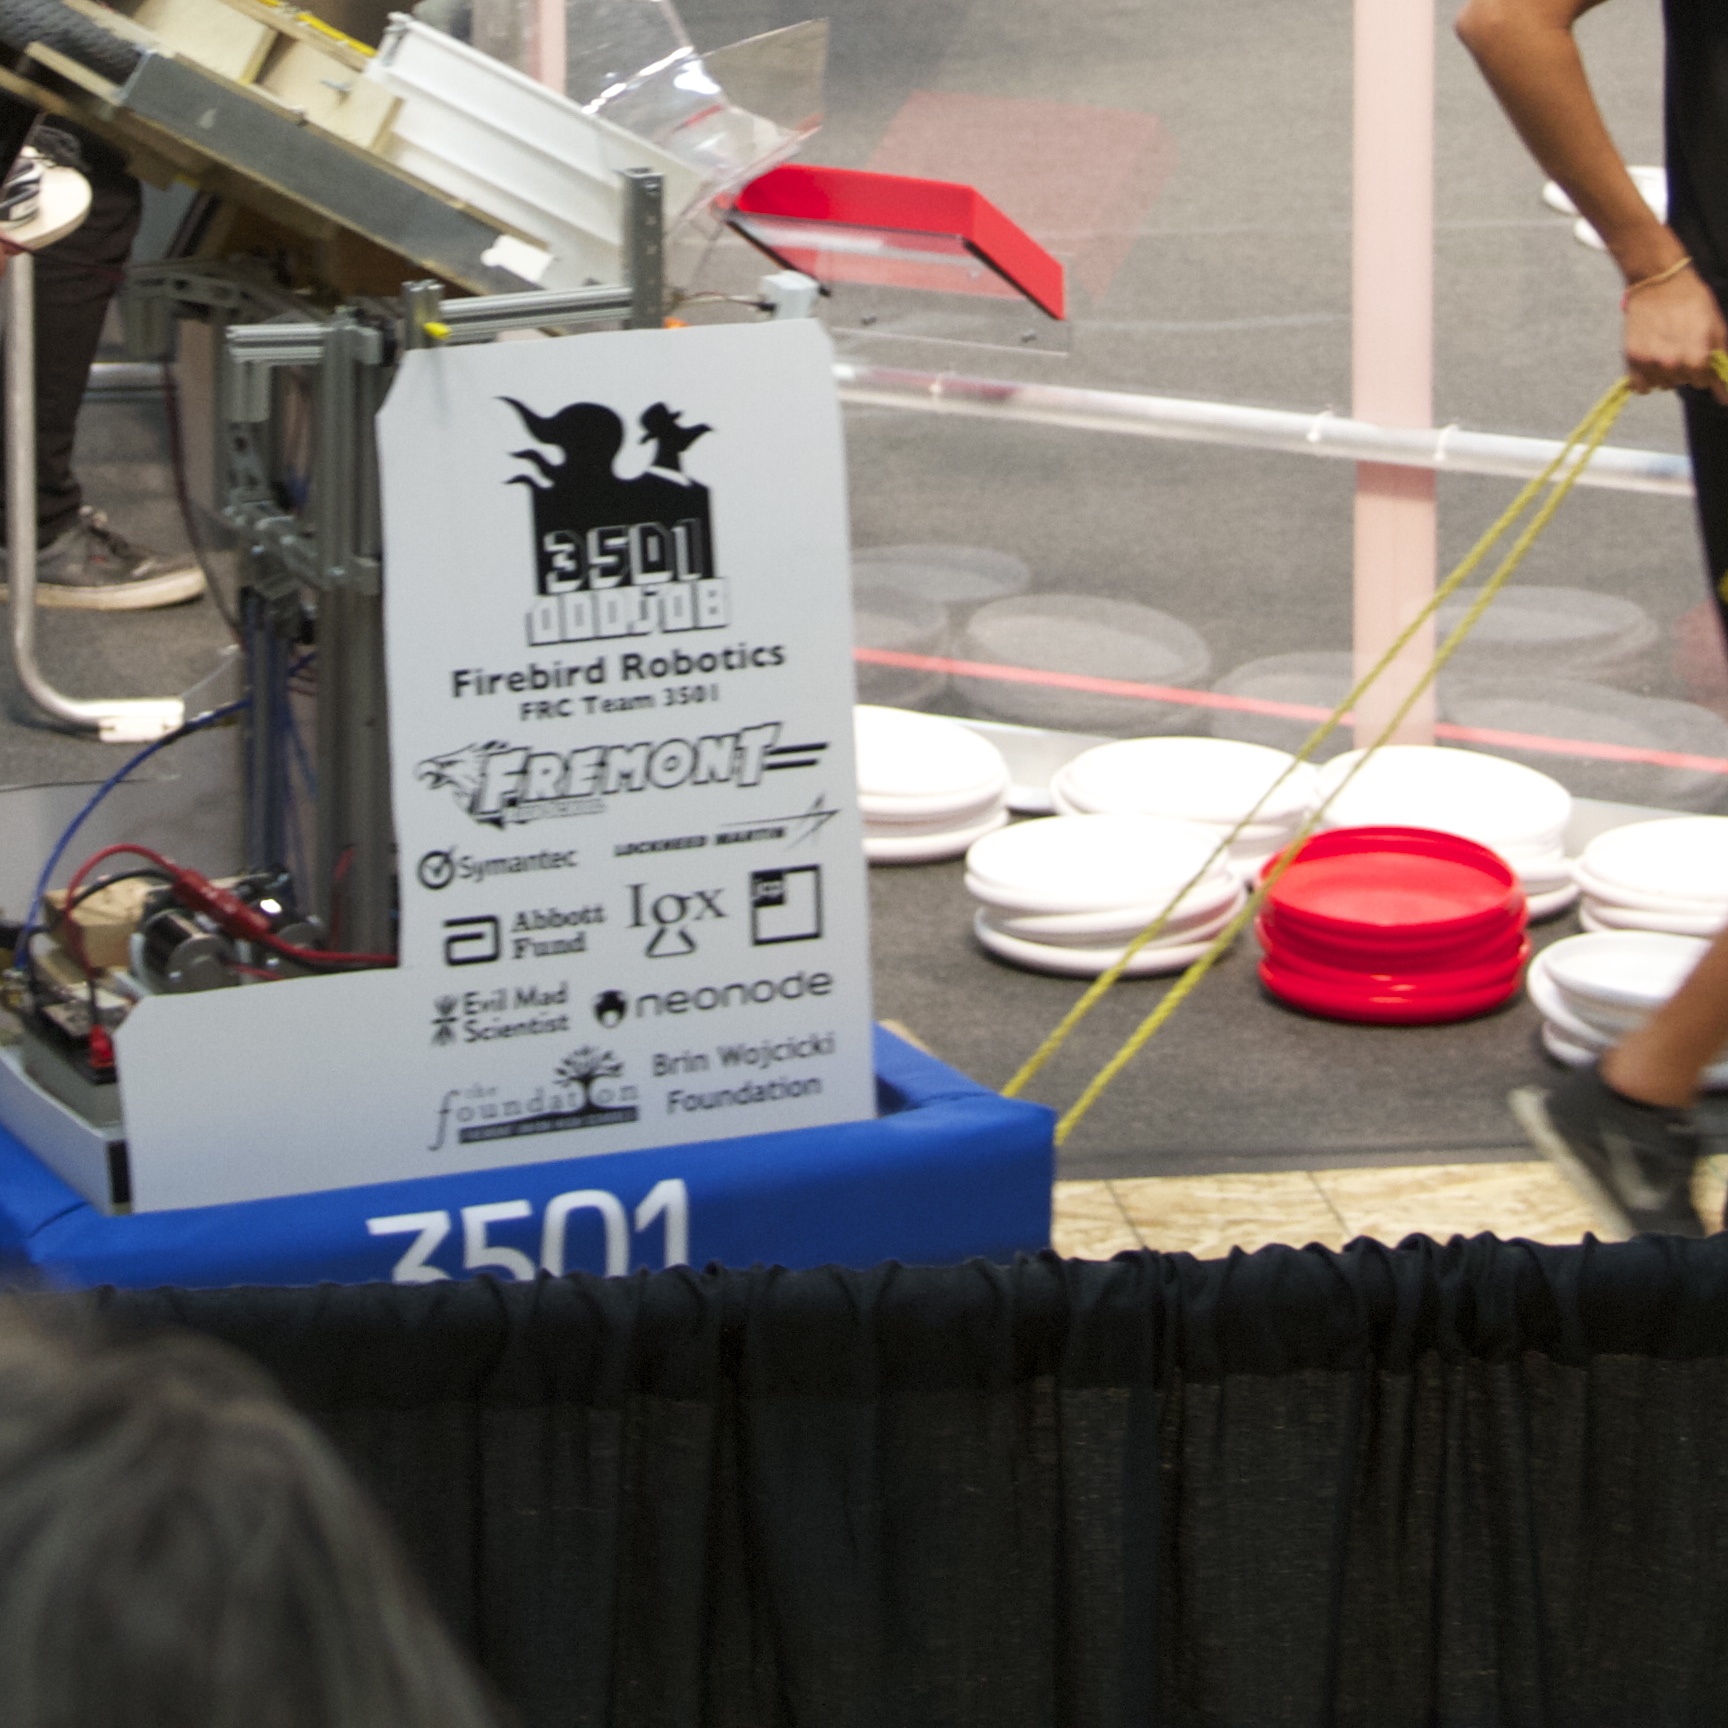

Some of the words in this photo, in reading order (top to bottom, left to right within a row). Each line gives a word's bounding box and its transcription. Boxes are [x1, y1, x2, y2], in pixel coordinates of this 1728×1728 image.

[542, 518, 706, 594] 3501
[451, 656, 606, 698] Firebird
[620, 642, 787, 682] Robotics
[520, 695, 573, 722] FRC
[582, 692, 657, 715] Team
[663, 684, 720, 707] 3501
[474, 721, 783, 817] FREMONT
[613, 835, 708, 857] LOCKHEED
[714, 826, 785, 846] MARTIN
[458, 850, 578, 883] Symantec
[511, 904, 607, 934] Abbott
[511, 932, 587, 960] Fund
[463, 986, 509, 1017] Evil
[514, 980, 569, 1009] Mad
[636, 971, 834, 1018] neonode
[463, 1013, 570, 1045] Scientist
[651, 1050, 710, 1078] Brin
[716, 1032, 836, 1070] Wojcicki
[666, 1077, 823, 1115] Foundation
